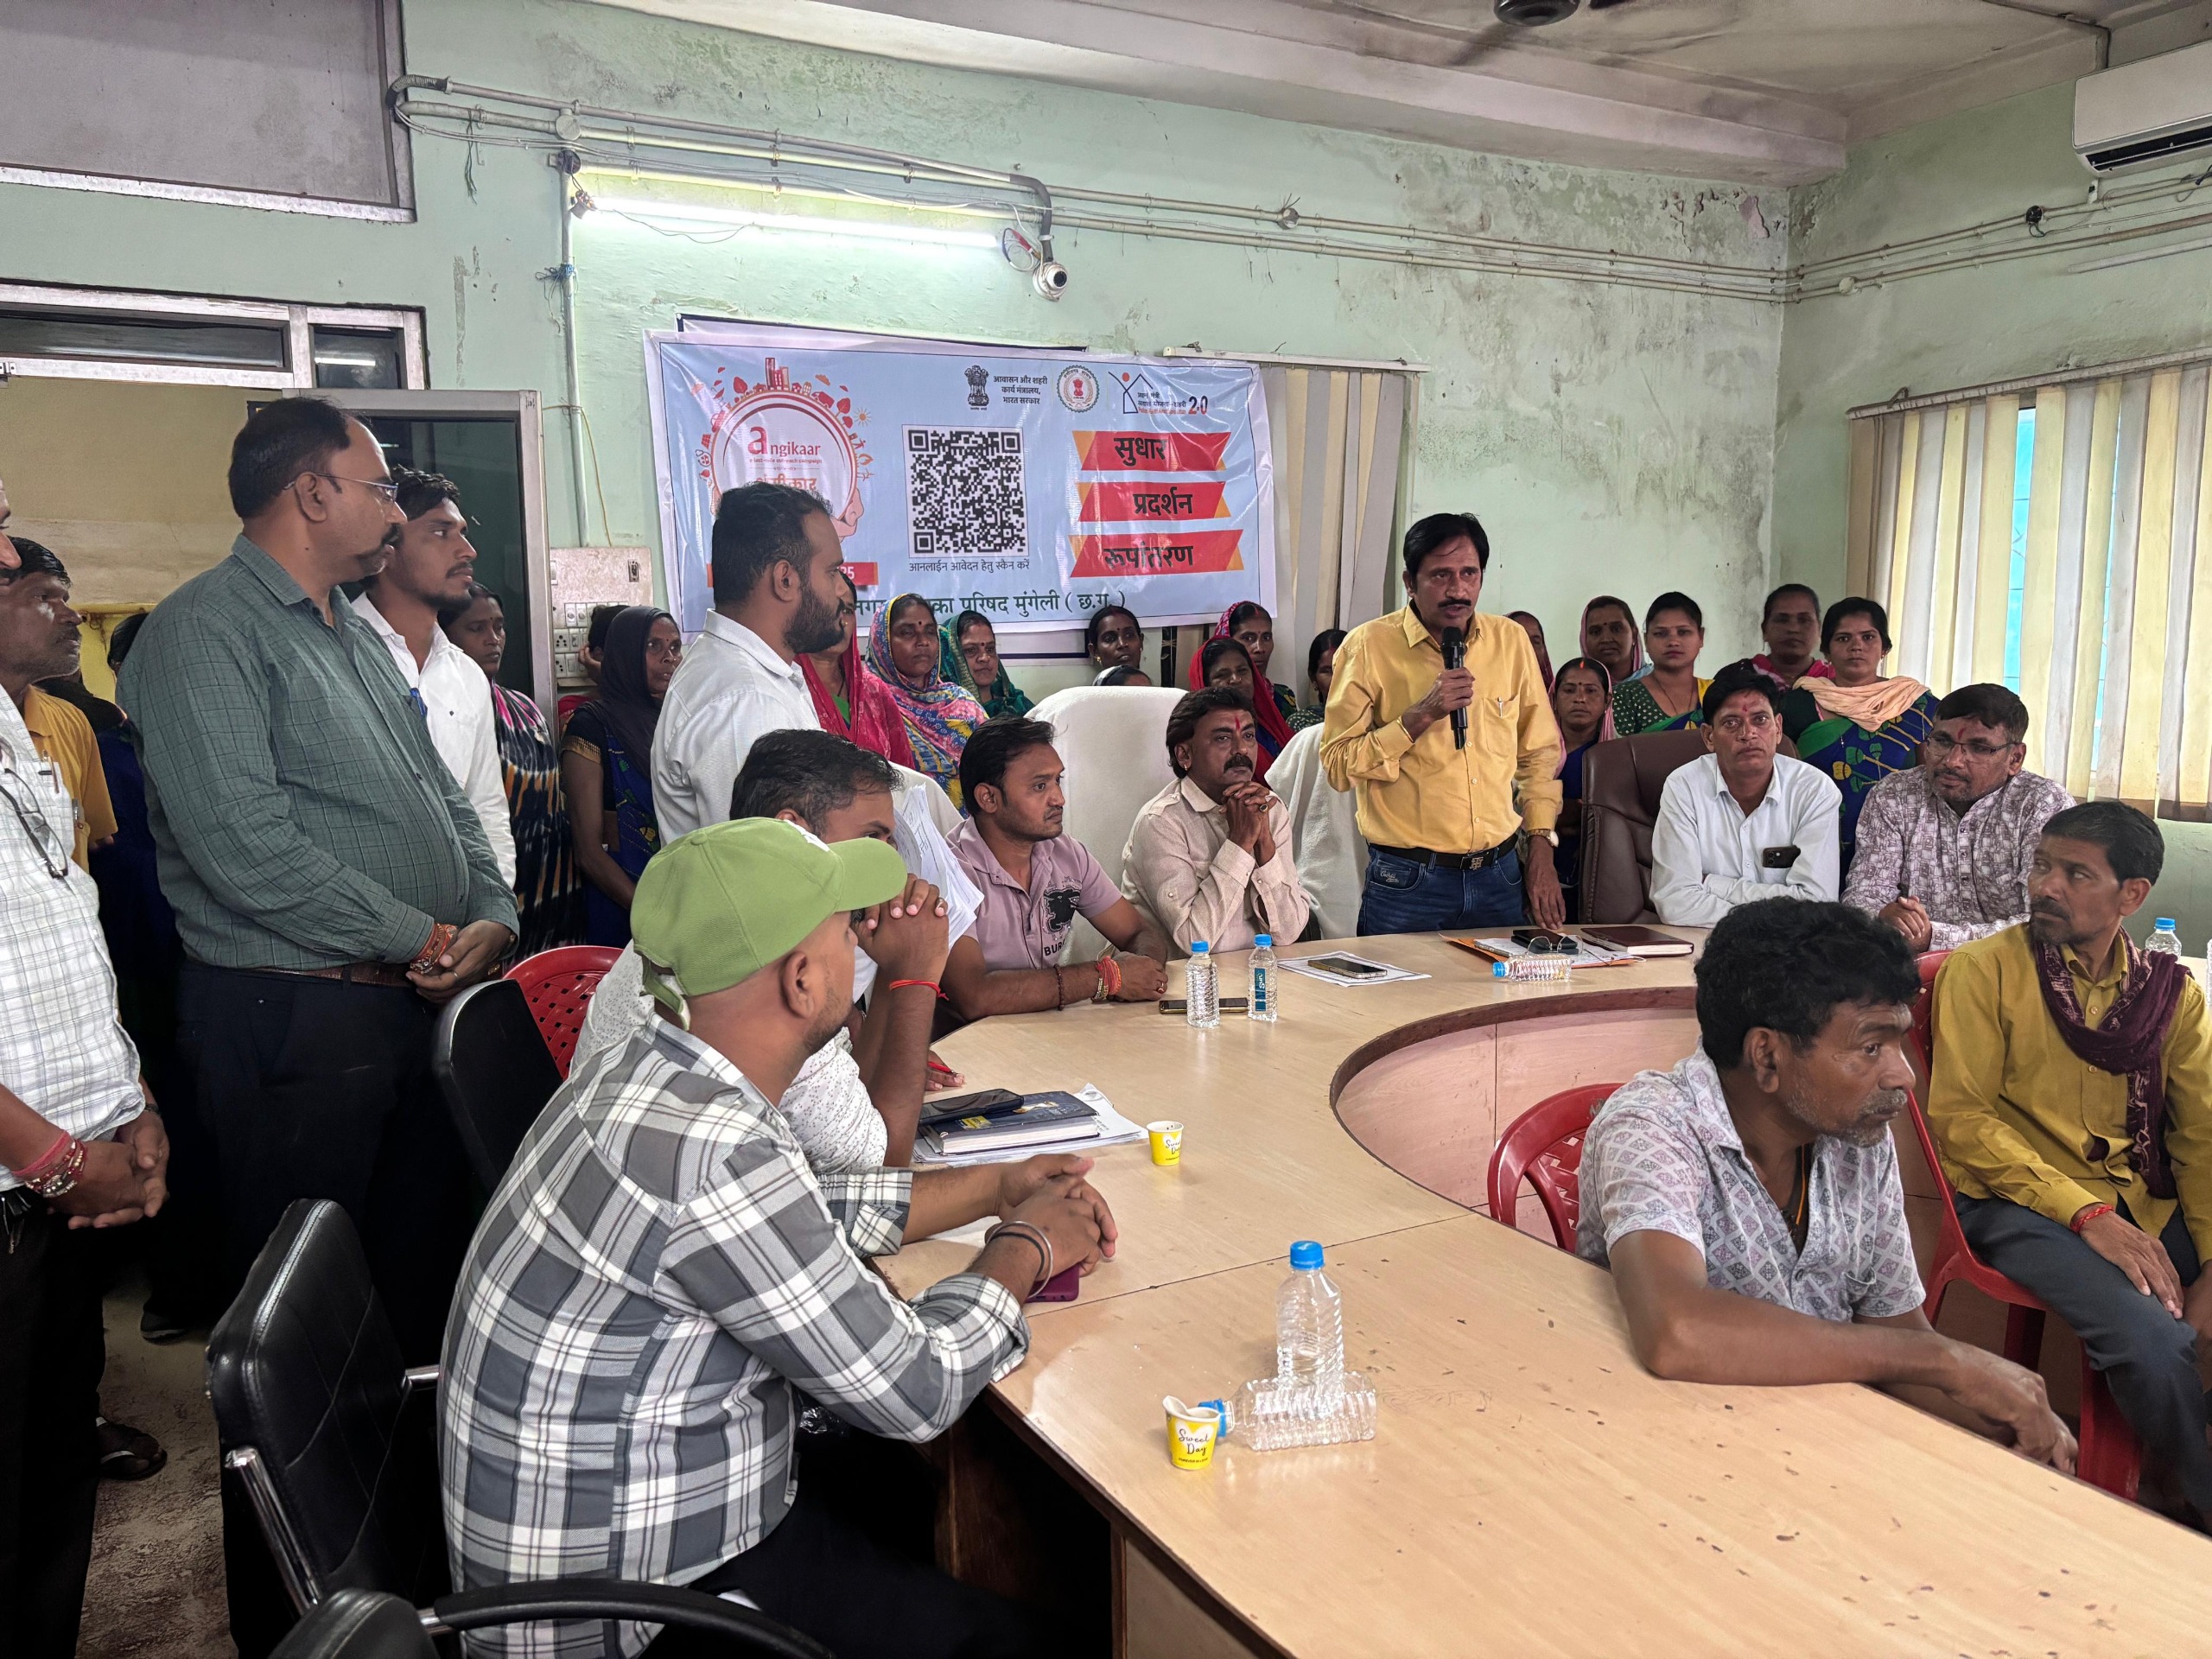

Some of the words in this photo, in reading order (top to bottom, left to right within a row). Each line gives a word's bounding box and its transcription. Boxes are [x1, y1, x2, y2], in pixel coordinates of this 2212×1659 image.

[1020, 375, 1032, 384] और
[1033, 376, 1048, 385] शहरी
[1001, 385, 1015, 393] कार्य
[1188, 395, 1208, 415] 2.0
[1113, 437, 1168, 467] सुधार
[1133, 486, 1193, 517] प्रदर्शन
[1103, 541, 1194, 569] रूपांतरण
[950, 559, 978, 571] आवेदन
[981, 559, 994, 573] हेतु
[1017, 558, 1030, 570] करें
[959, 591, 1009, 614] परिषद
[1013, 588, 1060, 618] मुंगेली
[1179, 1428, 1210, 1442] Sweet
[1186, 1443, 1207, 1457] Day
